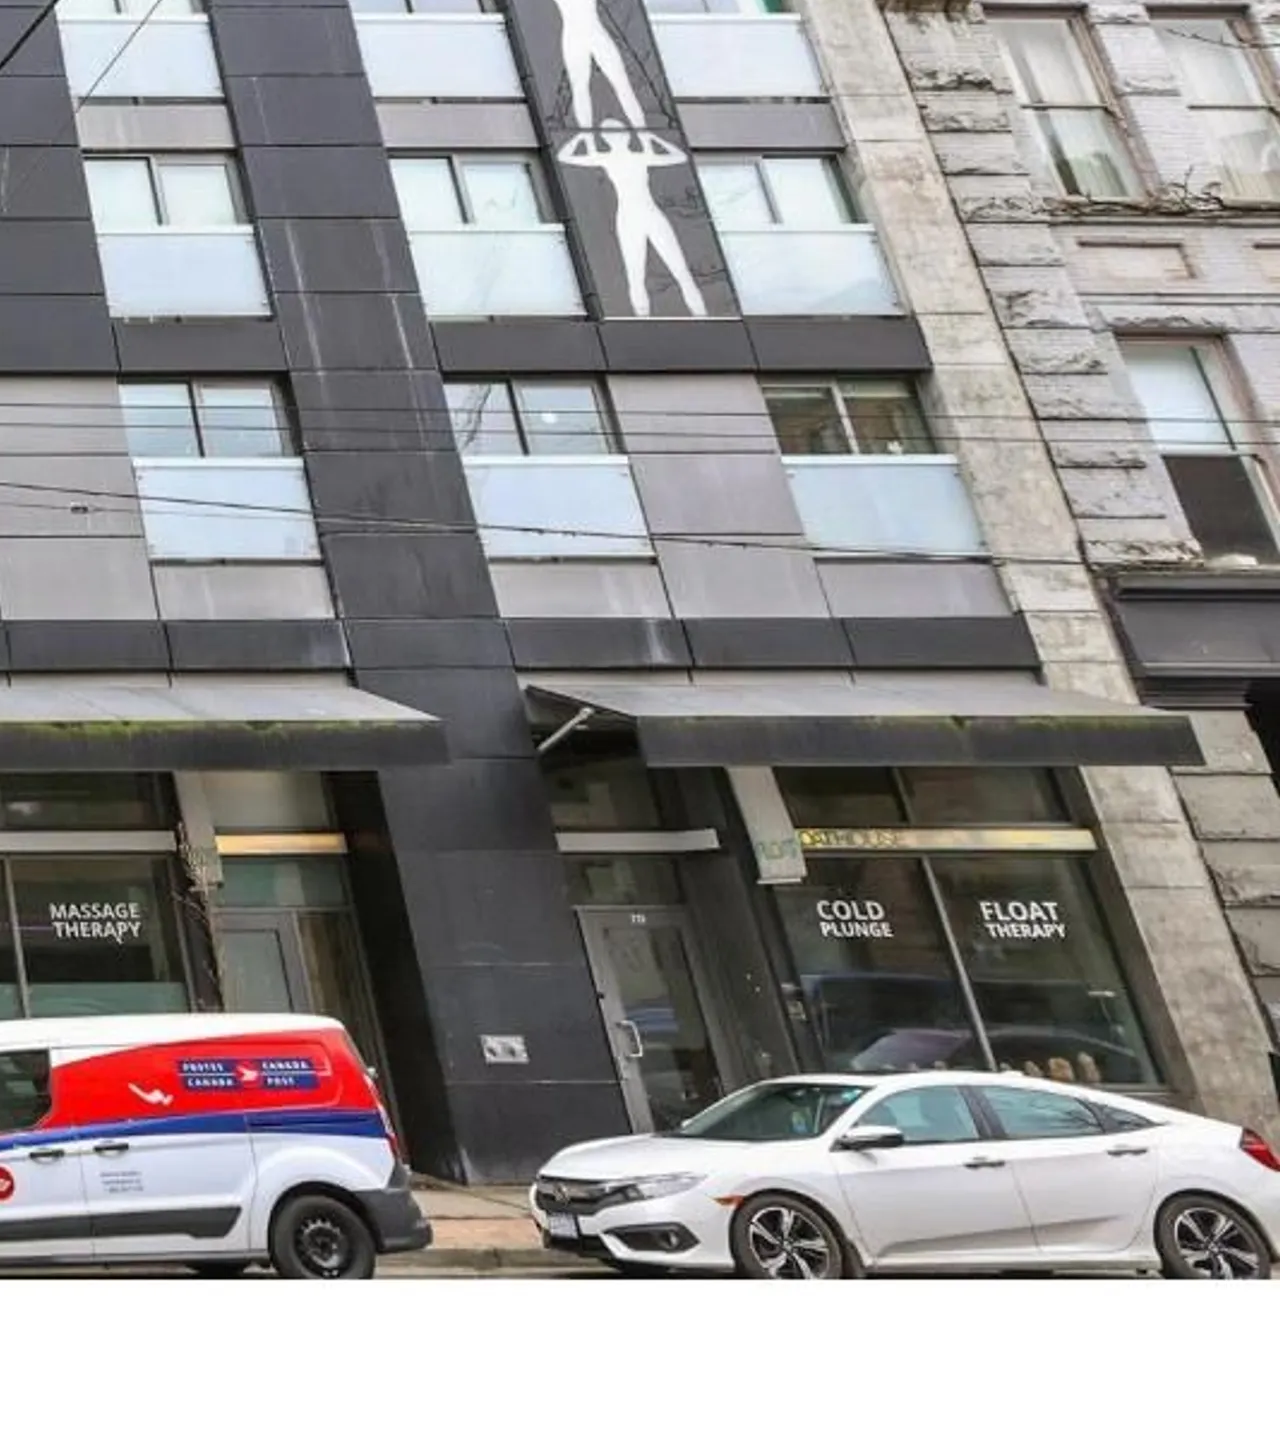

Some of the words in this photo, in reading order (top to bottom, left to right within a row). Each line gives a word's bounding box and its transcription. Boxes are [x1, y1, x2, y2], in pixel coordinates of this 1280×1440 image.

[49, 902, 140, 920] MASSAGE
[817, 900, 885, 921] COLD
[980, 901, 1058, 922] FLOAT
[52, 921, 141, 939] THERAPY
[820, 922, 894, 938] PLUNGE
[985, 923, 1066, 939] THERAPY
